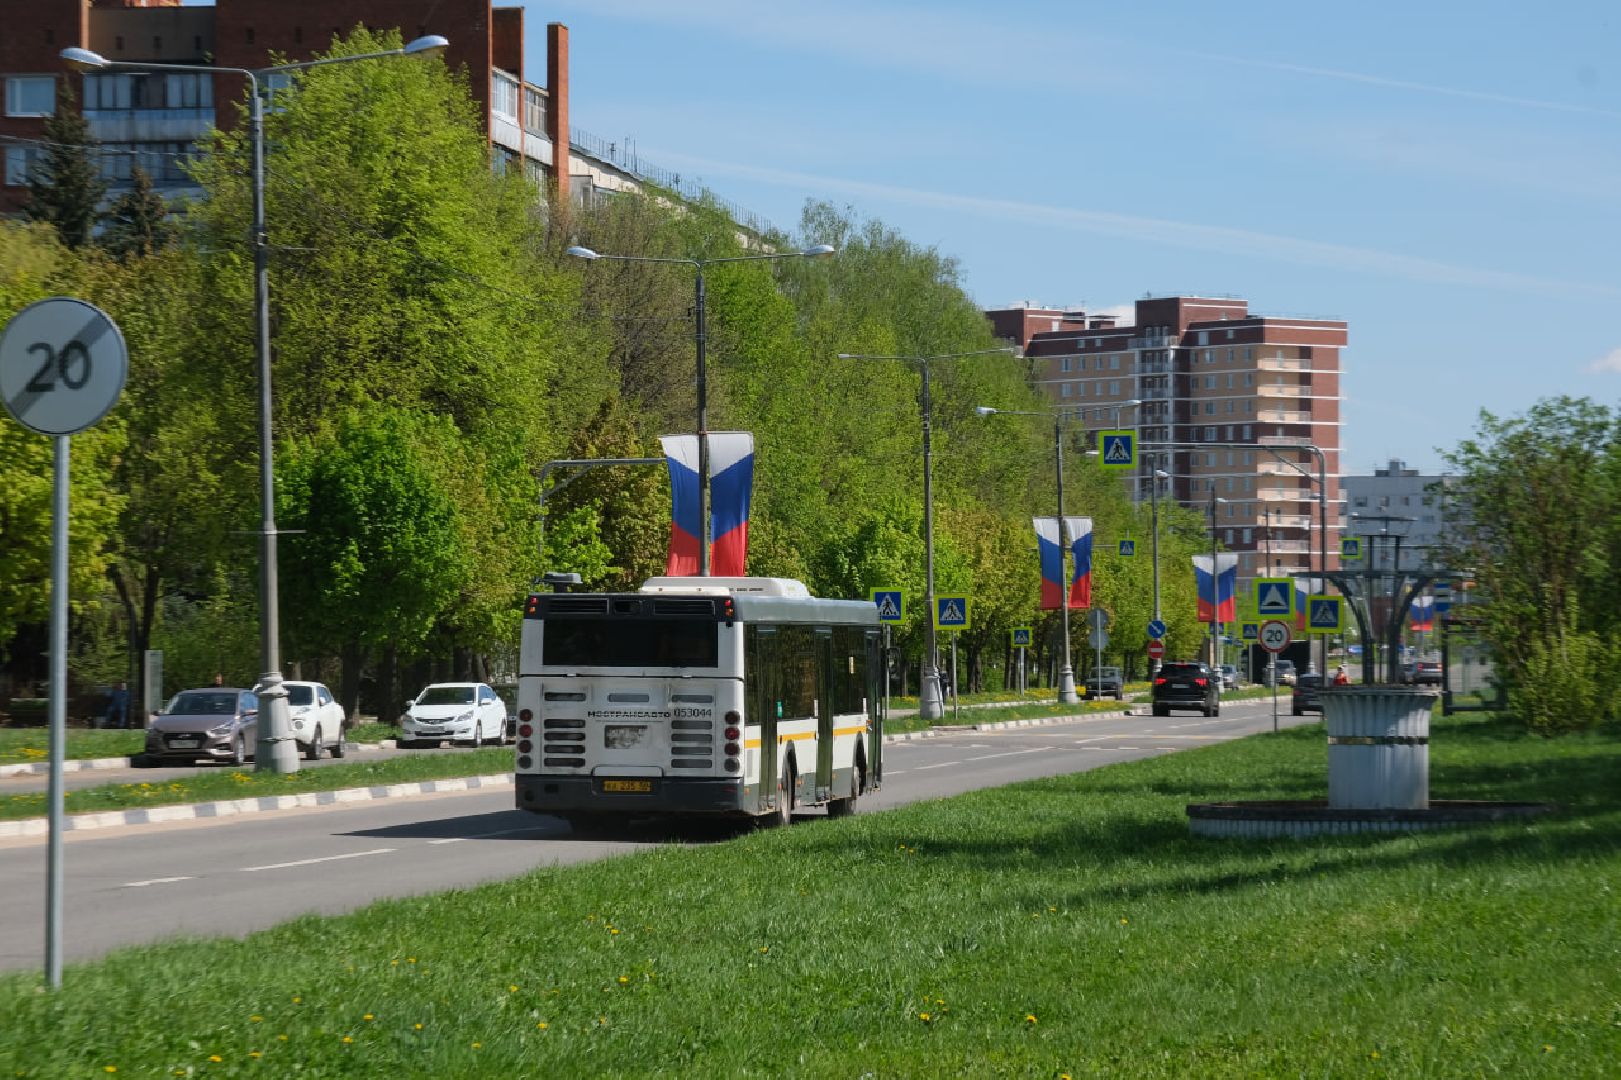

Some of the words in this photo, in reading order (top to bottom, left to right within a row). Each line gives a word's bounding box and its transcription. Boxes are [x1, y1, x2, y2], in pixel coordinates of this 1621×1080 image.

[27, 340, 92, 393] 20
[1266, 629, 1283, 642] 20
[673, 708, 712, 718] 053044
